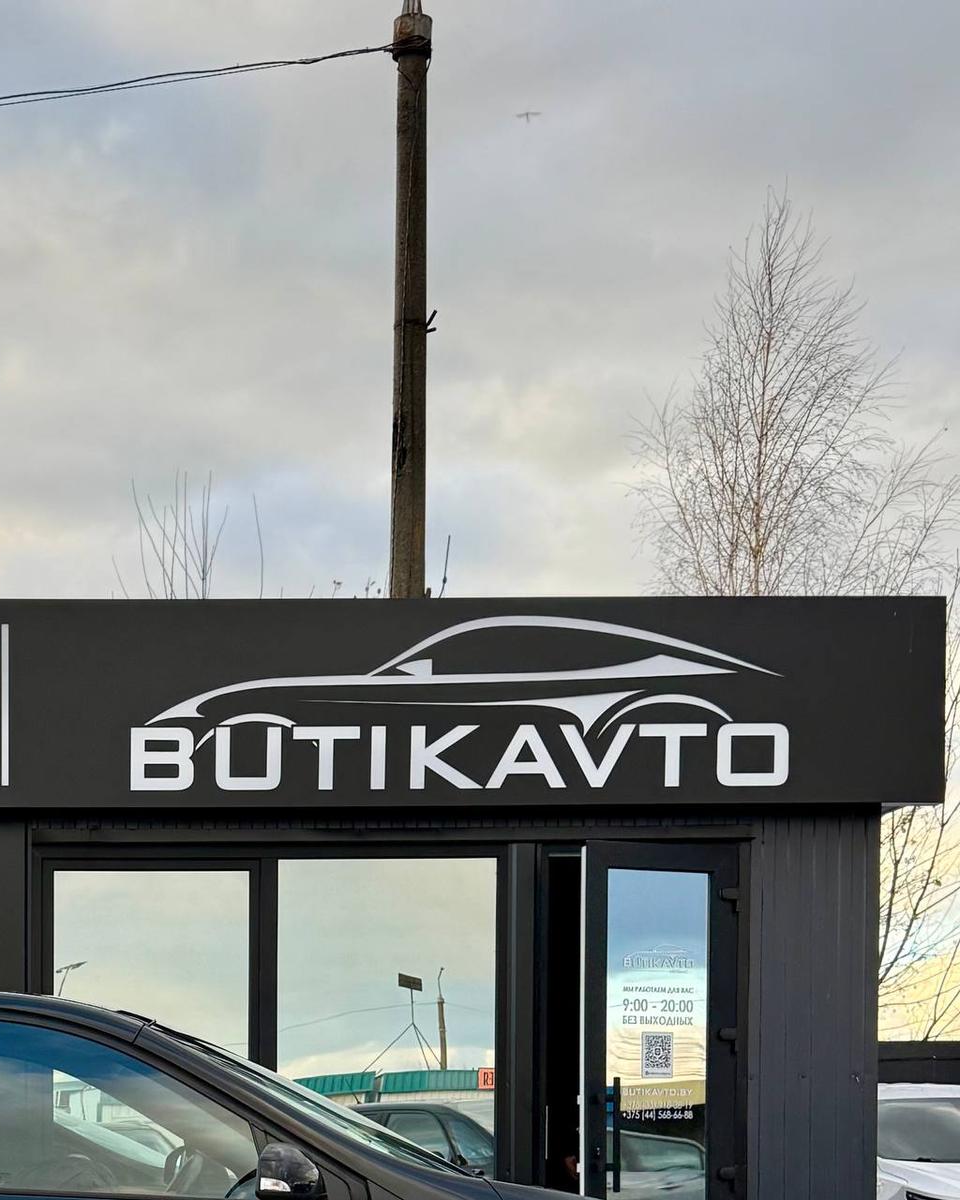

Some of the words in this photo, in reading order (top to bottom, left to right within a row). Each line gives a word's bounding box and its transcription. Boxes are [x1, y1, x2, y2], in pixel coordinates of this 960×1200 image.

[130, 723, 789, 790] BUTIKAVTO
[623, 998, 648, 1012] 9:00
[661, 999, 693, 1013] 20:00
[622, 1015, 637, 1025] БЕЗ
[640, 1016, 693, 1026] ВЫХОДНЫХ
[622, 1088, 693, 1096] BUTIKAVTO.BY
[623, 1111, 640, 1120] +375
